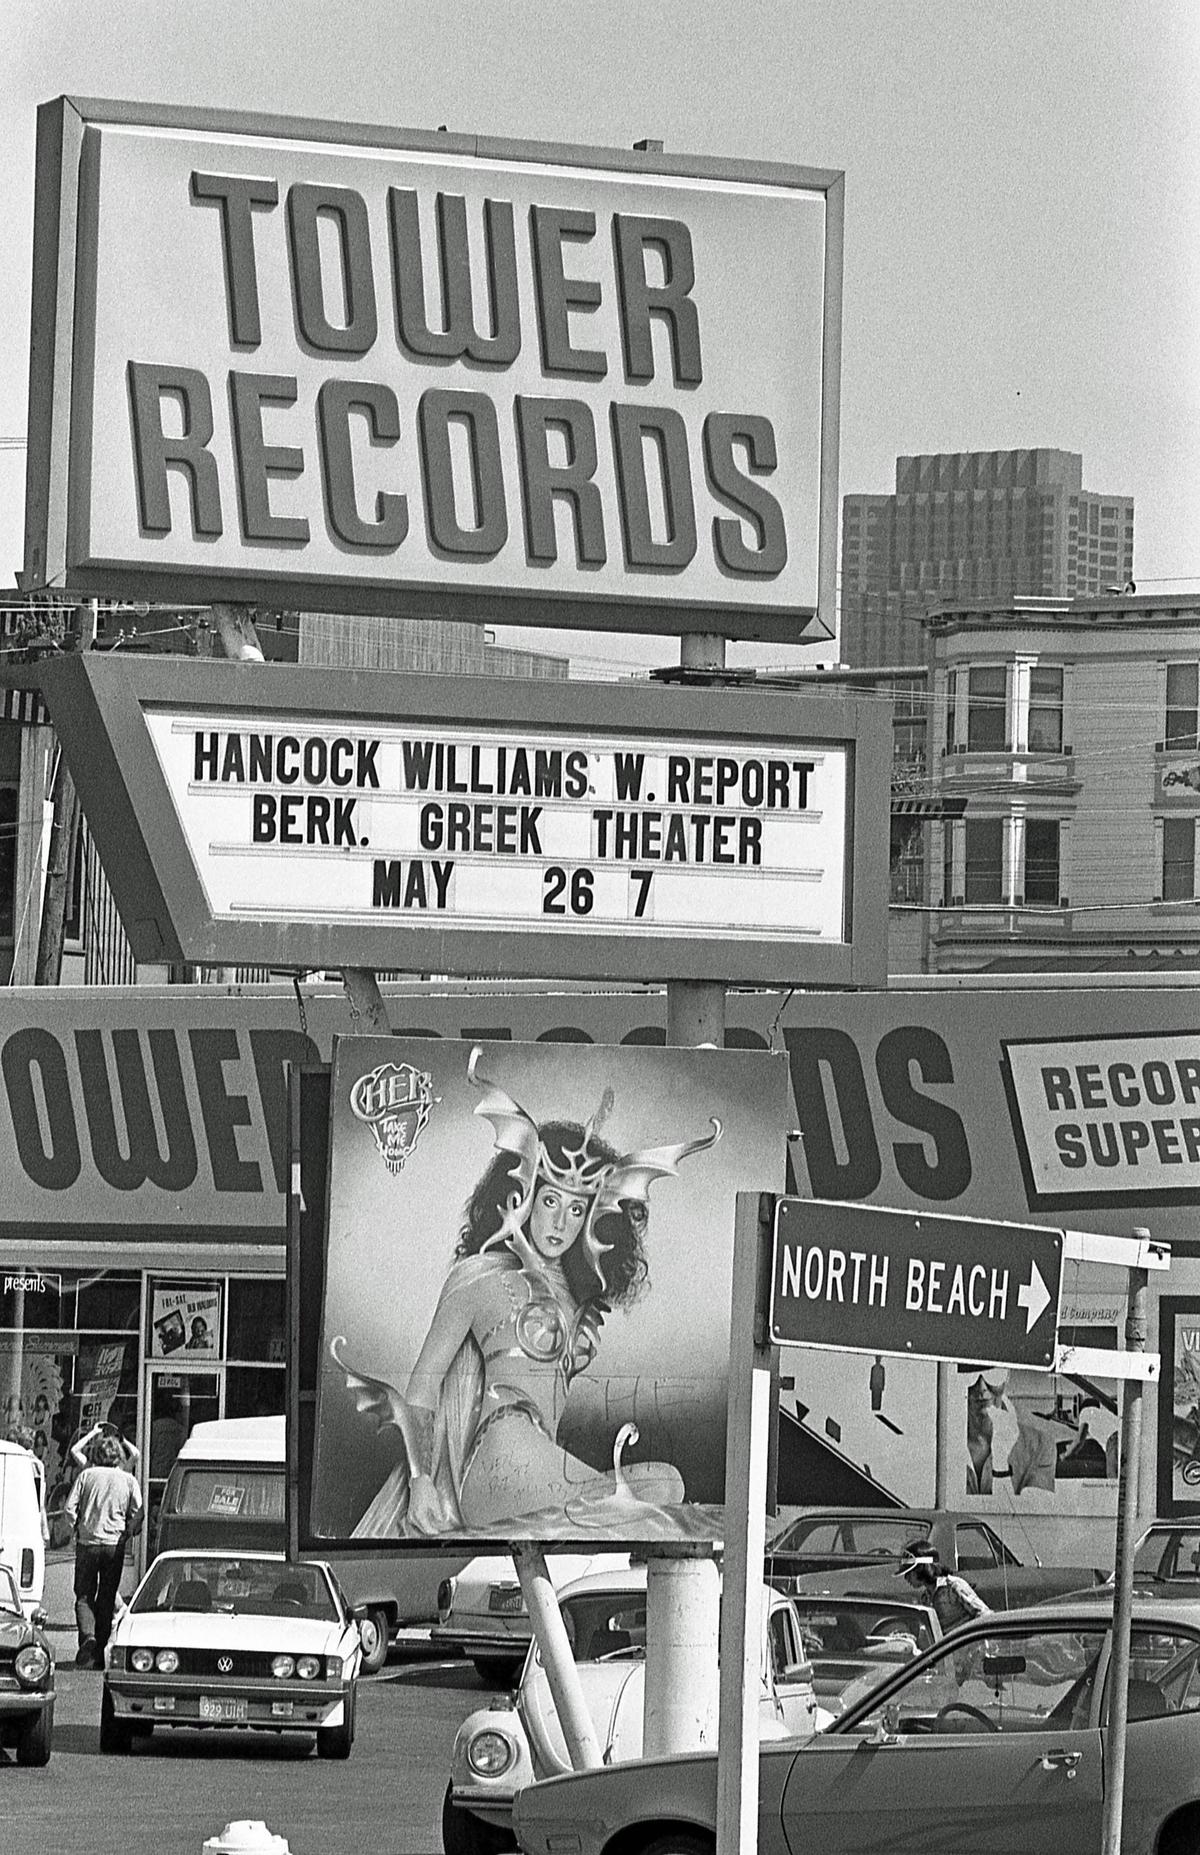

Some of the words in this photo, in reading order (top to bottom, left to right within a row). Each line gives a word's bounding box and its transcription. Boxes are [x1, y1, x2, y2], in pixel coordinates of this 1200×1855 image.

[190, 169, 704, 392] TOWER
[126, 358, 789, 583] RECORDS
[194, 731, 380, 788] HANCOCK
[402, 740, 588, 798] WILLIAMS
[253, 794, 370, 846] BERK.
[420, 802, 543, 855] GREEK
[593, 810, 762, 865] THEATER
[372, 860, 454, 909] MAY
[543, 866, 594, 915] 26
[630, 870, 654, 917] 7
[350, 1071, 442, 1120] CHER
[379, 1114, 408, 1134] TAKE
[387, 1133, 407, 1147] ME
[3, 1273, 46, 1295] presents
[781, 1244, 889, 1307] NORTH
[905, 1258, 1009, 1320] BEACH
